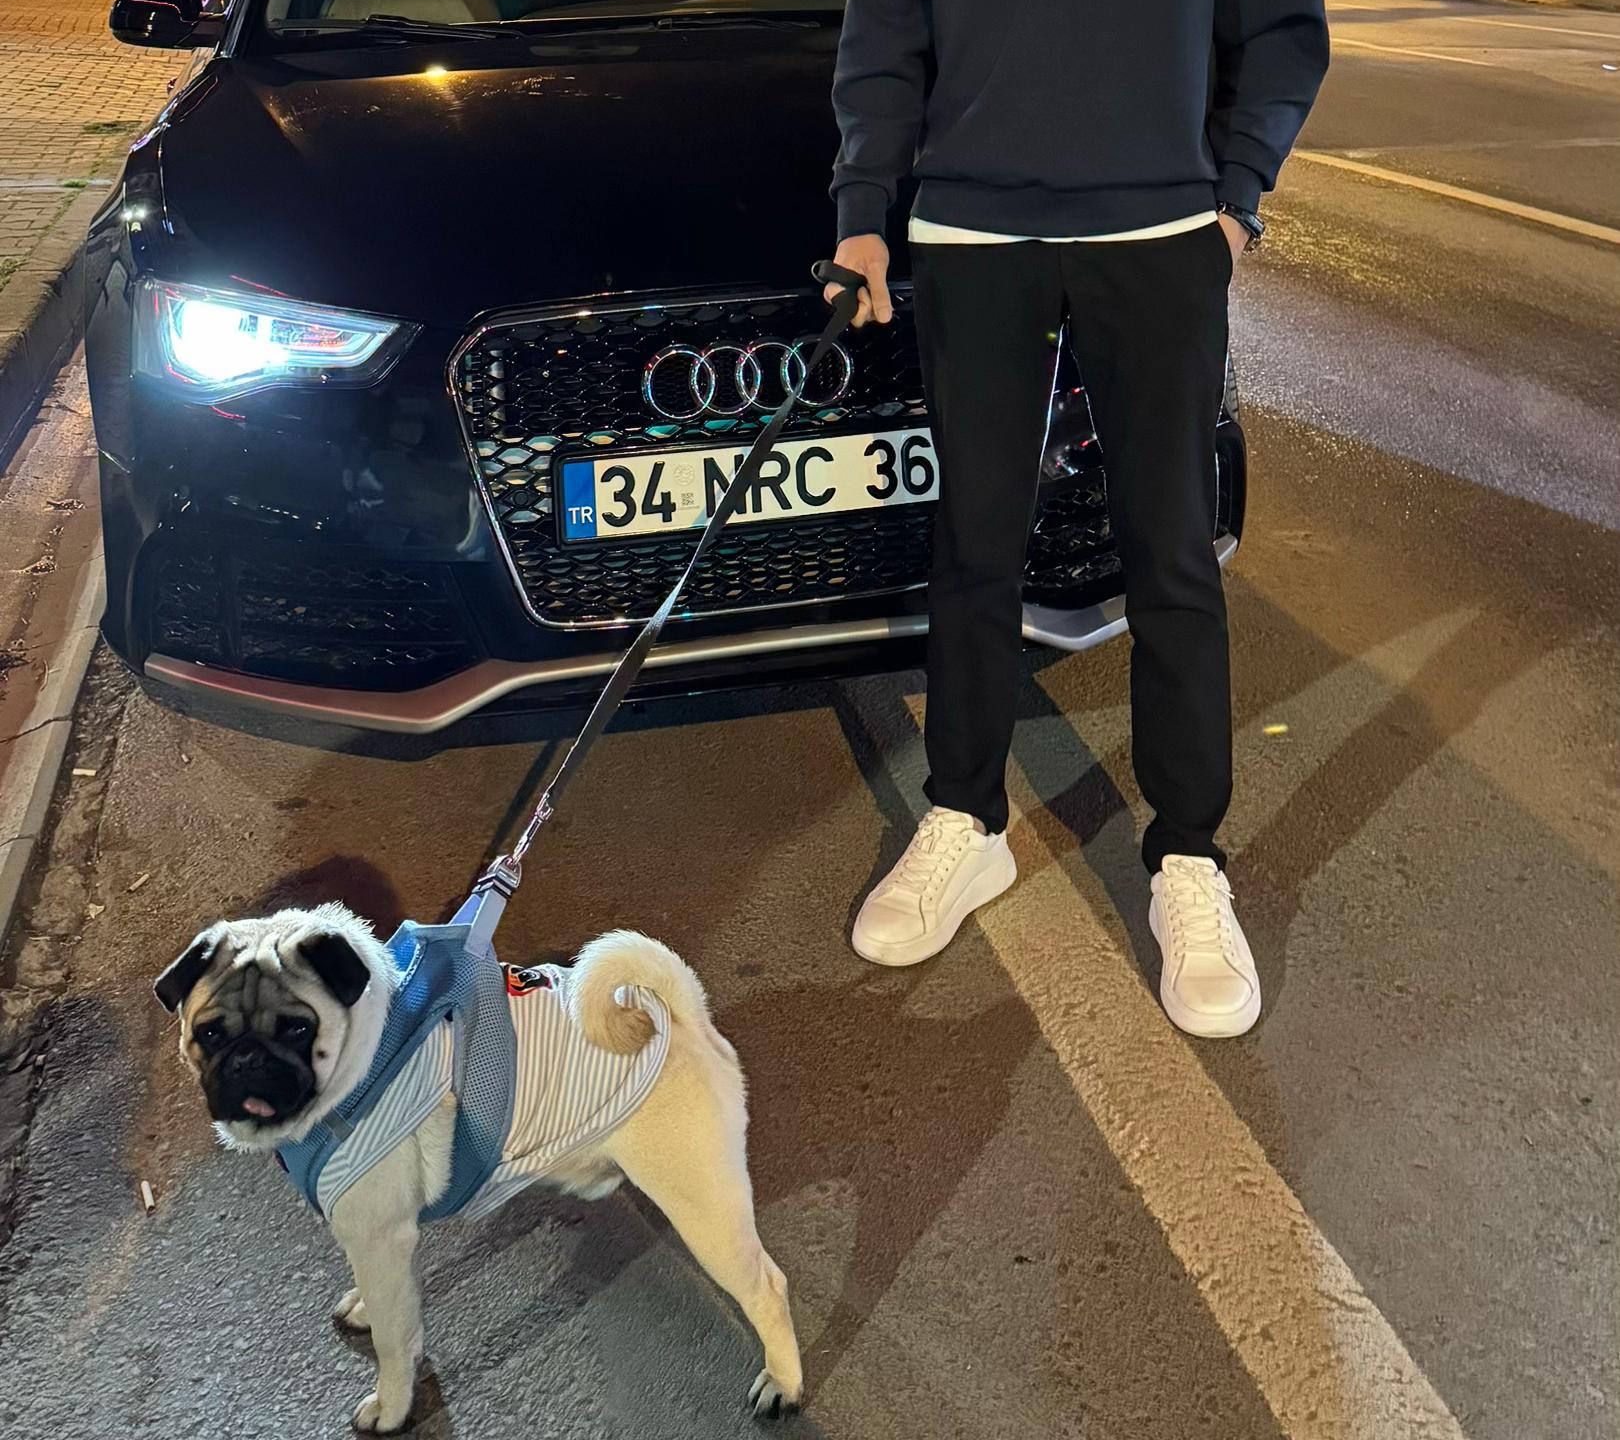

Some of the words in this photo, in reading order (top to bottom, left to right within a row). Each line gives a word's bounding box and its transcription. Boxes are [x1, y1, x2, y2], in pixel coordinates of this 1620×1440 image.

[600, 461, 676, 528] 34
[703, 446, 837, 518] NRC
[863, 435, 935, 500] 36
[567, 505, 594, 525] TR
